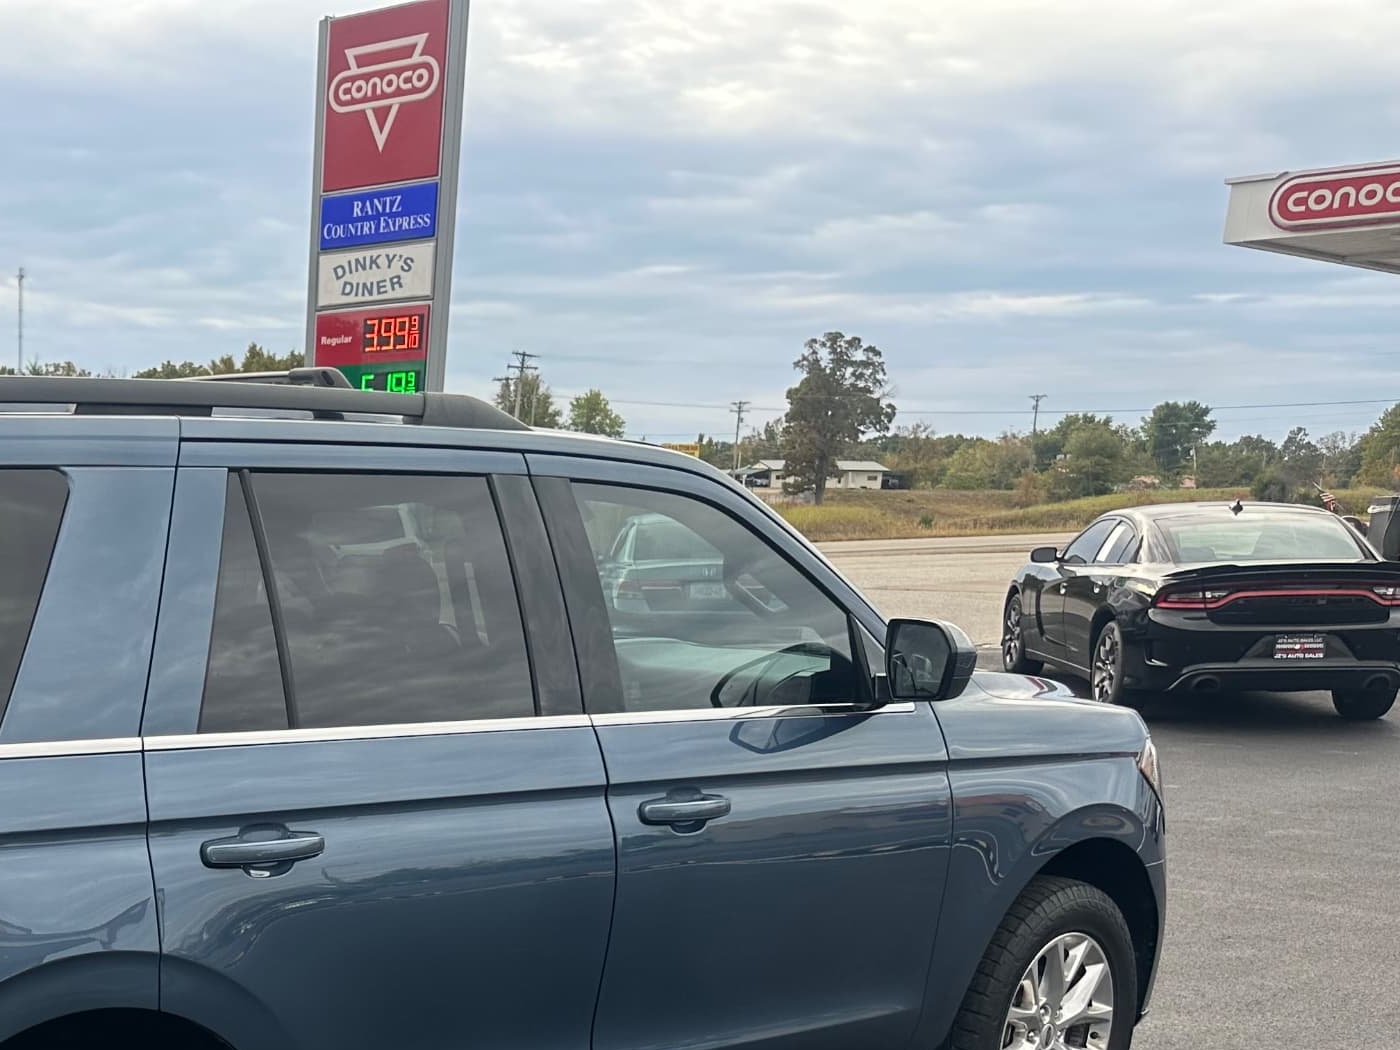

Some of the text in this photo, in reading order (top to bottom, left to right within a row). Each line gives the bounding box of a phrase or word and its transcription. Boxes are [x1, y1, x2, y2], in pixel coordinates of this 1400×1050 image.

[353, 195, 402, 217] RANTZ
[332, 254, 414, 280] DINKY'S
[341, 275, 403, 297] DINER
[321, 334, 352, 346] Regular
